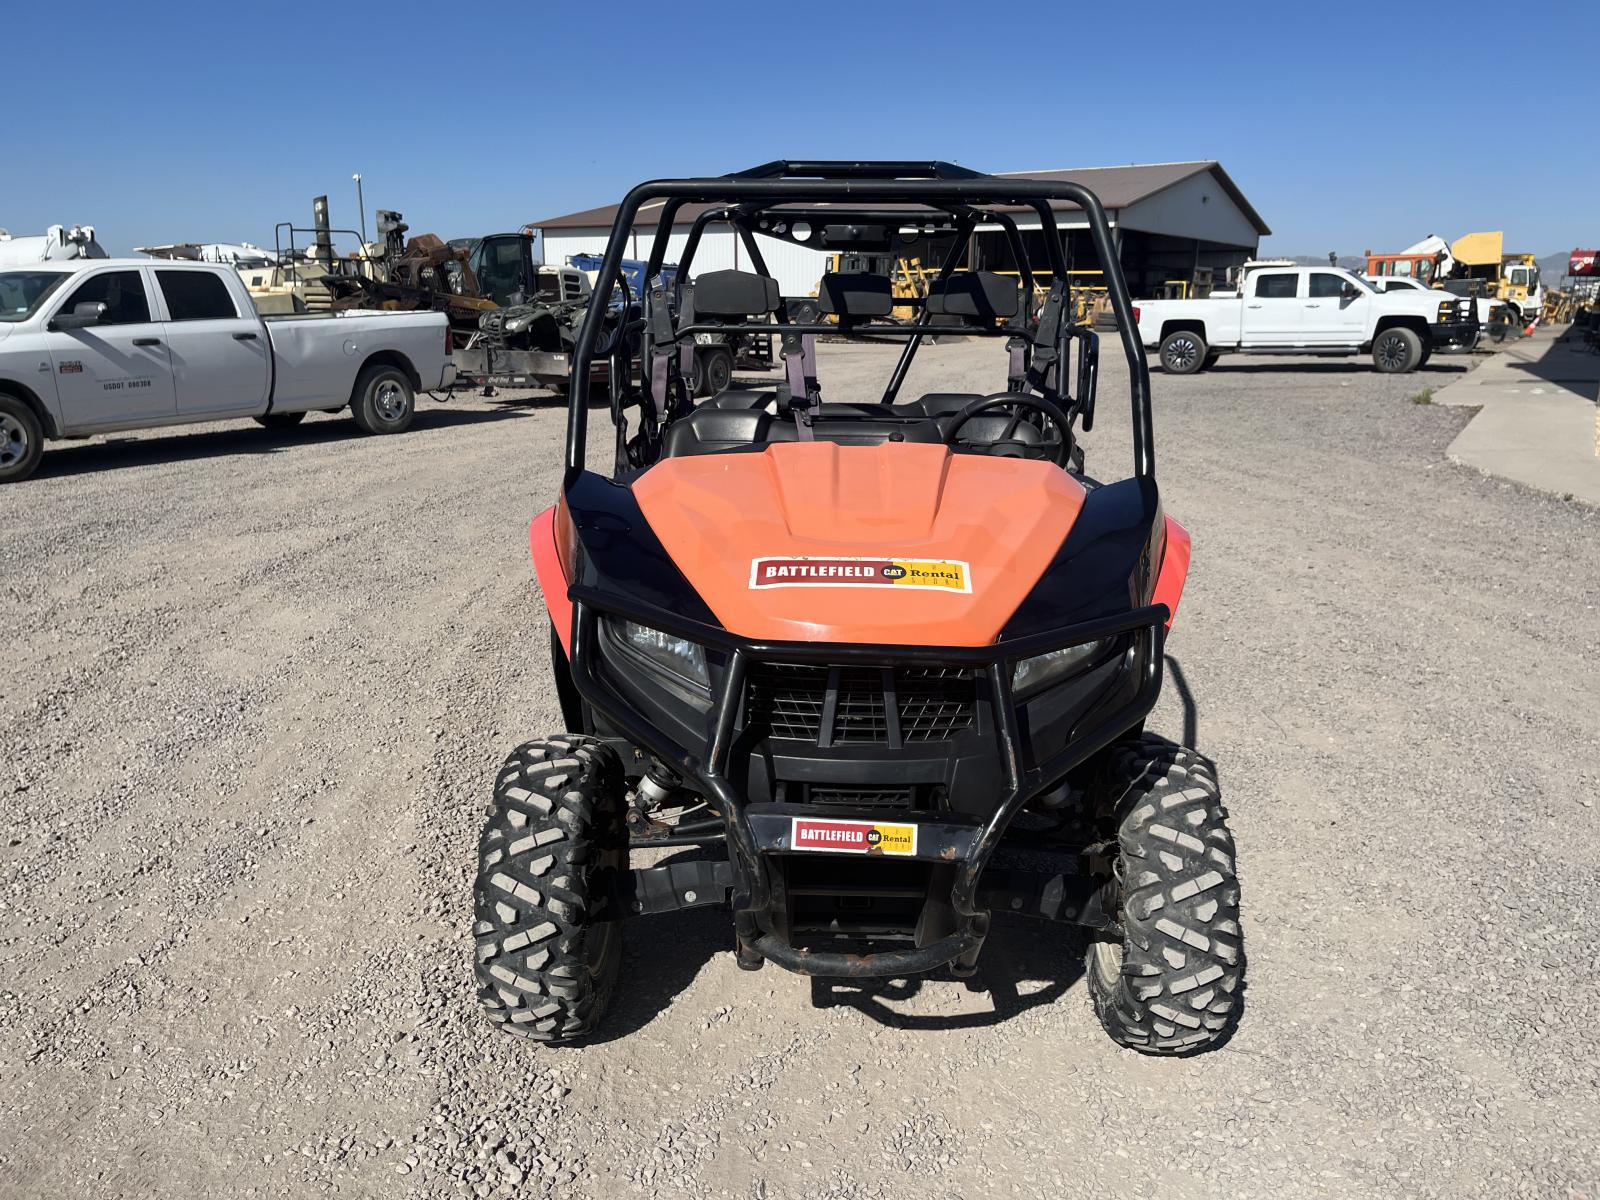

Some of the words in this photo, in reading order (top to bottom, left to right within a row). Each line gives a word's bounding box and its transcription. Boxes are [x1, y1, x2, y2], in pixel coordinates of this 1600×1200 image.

[103, 381, 125, 391] USDOT
[765, 565, 875, 578] BATTLEFIELD
[883, 568, 903, 577] CAT
[910, 569, 960, 580] Rental
[800, 828, 863, 842] BATTLEFIELD
[868, 833, 880, 841] CAT
[882, 834, 911, 843] Rental
